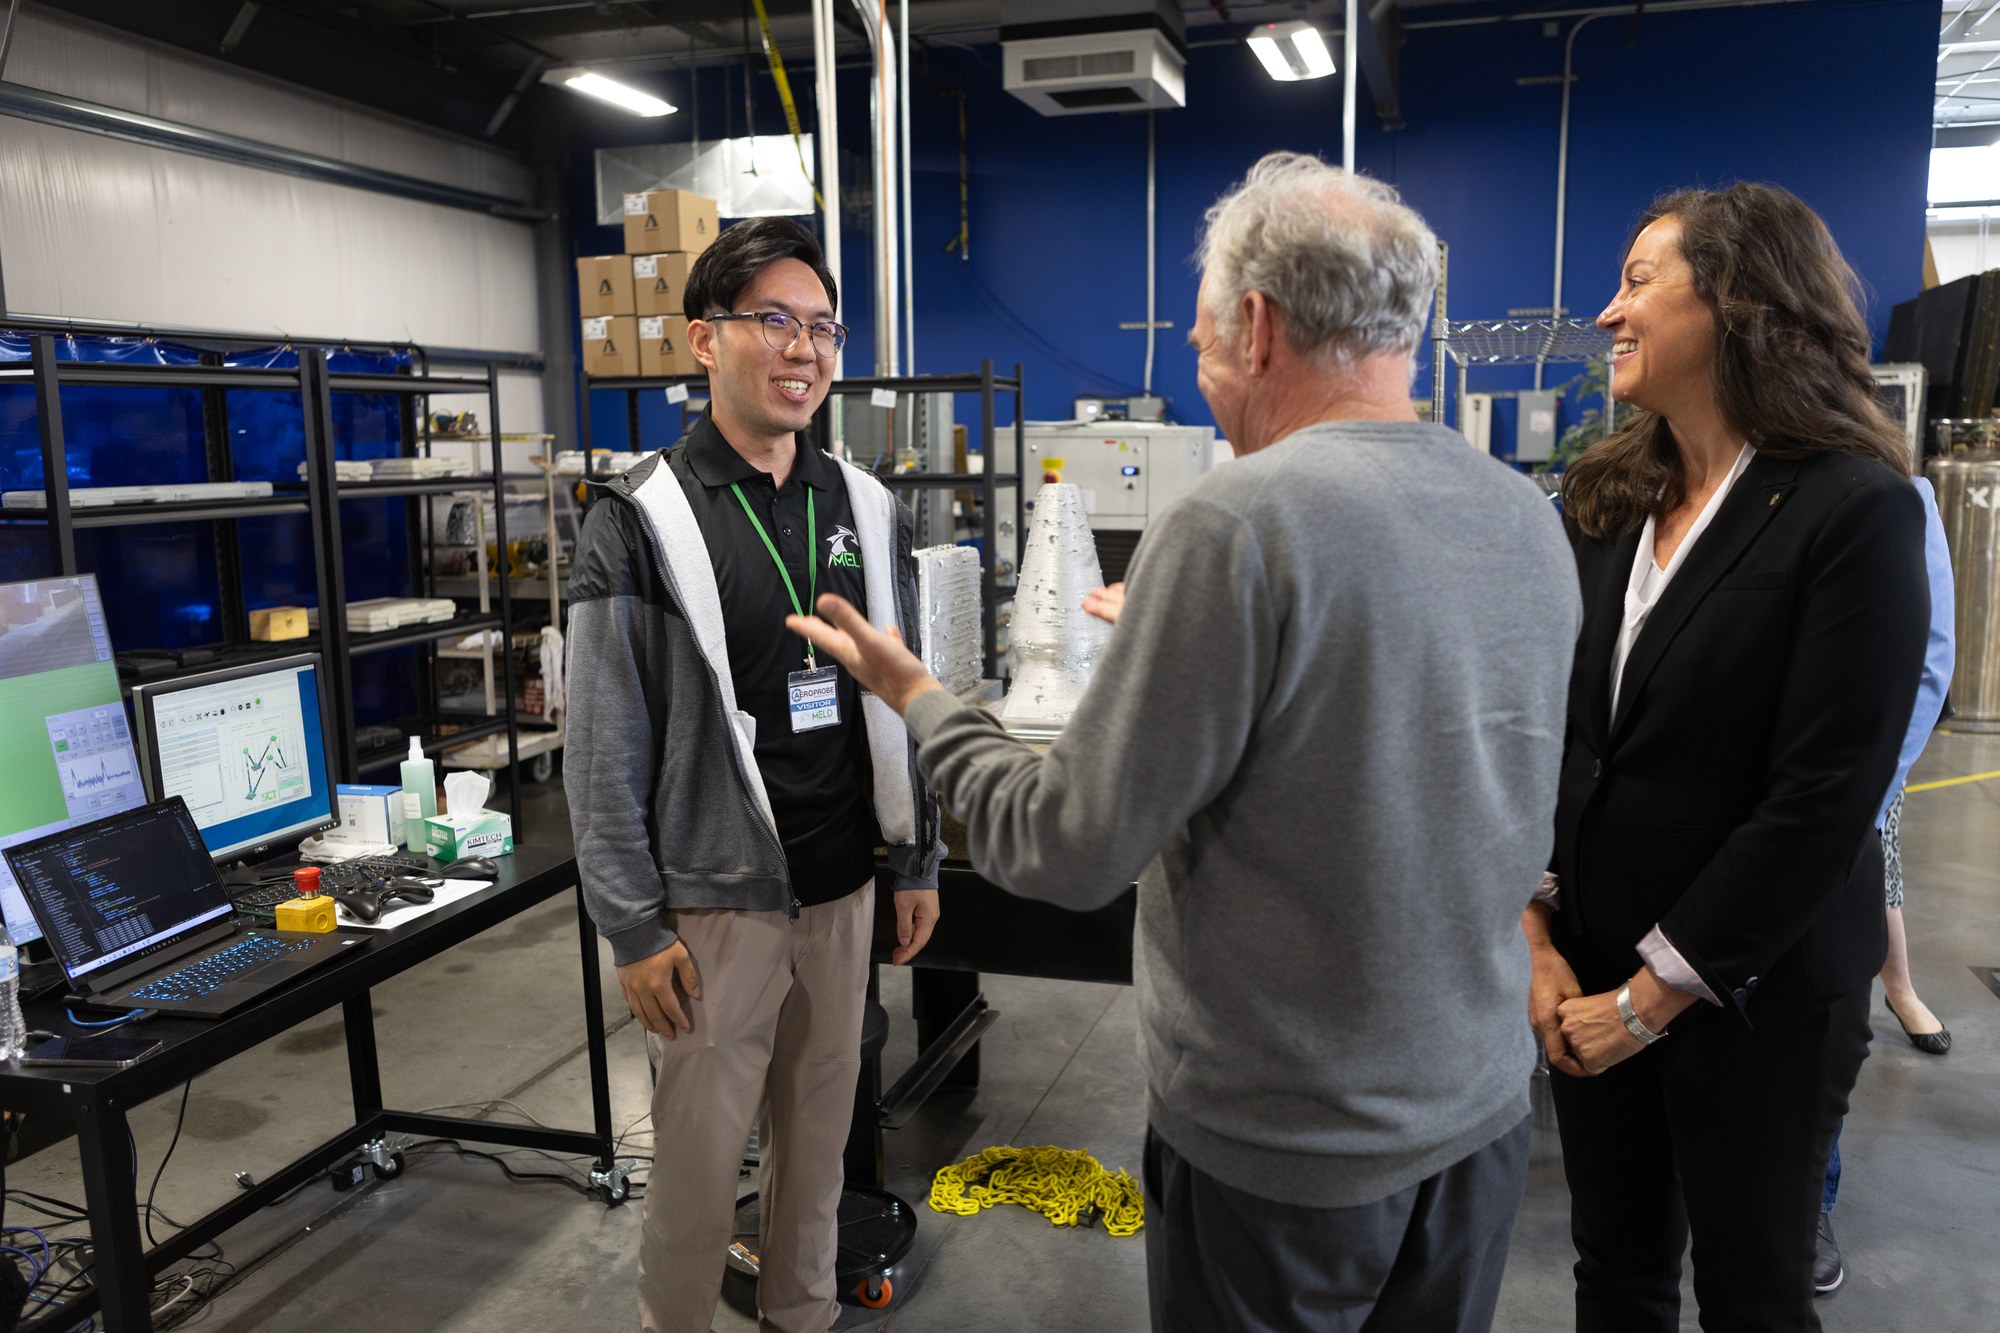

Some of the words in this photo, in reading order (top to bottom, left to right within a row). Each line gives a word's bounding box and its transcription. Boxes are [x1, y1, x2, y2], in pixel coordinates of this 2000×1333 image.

[797, 700, 832, 711] VISITOR
[812, 708, 833, 720] MELD
[467, 832, 502, 846] KIMTECH
[141, 935, 180, 956] ALIENWARE
